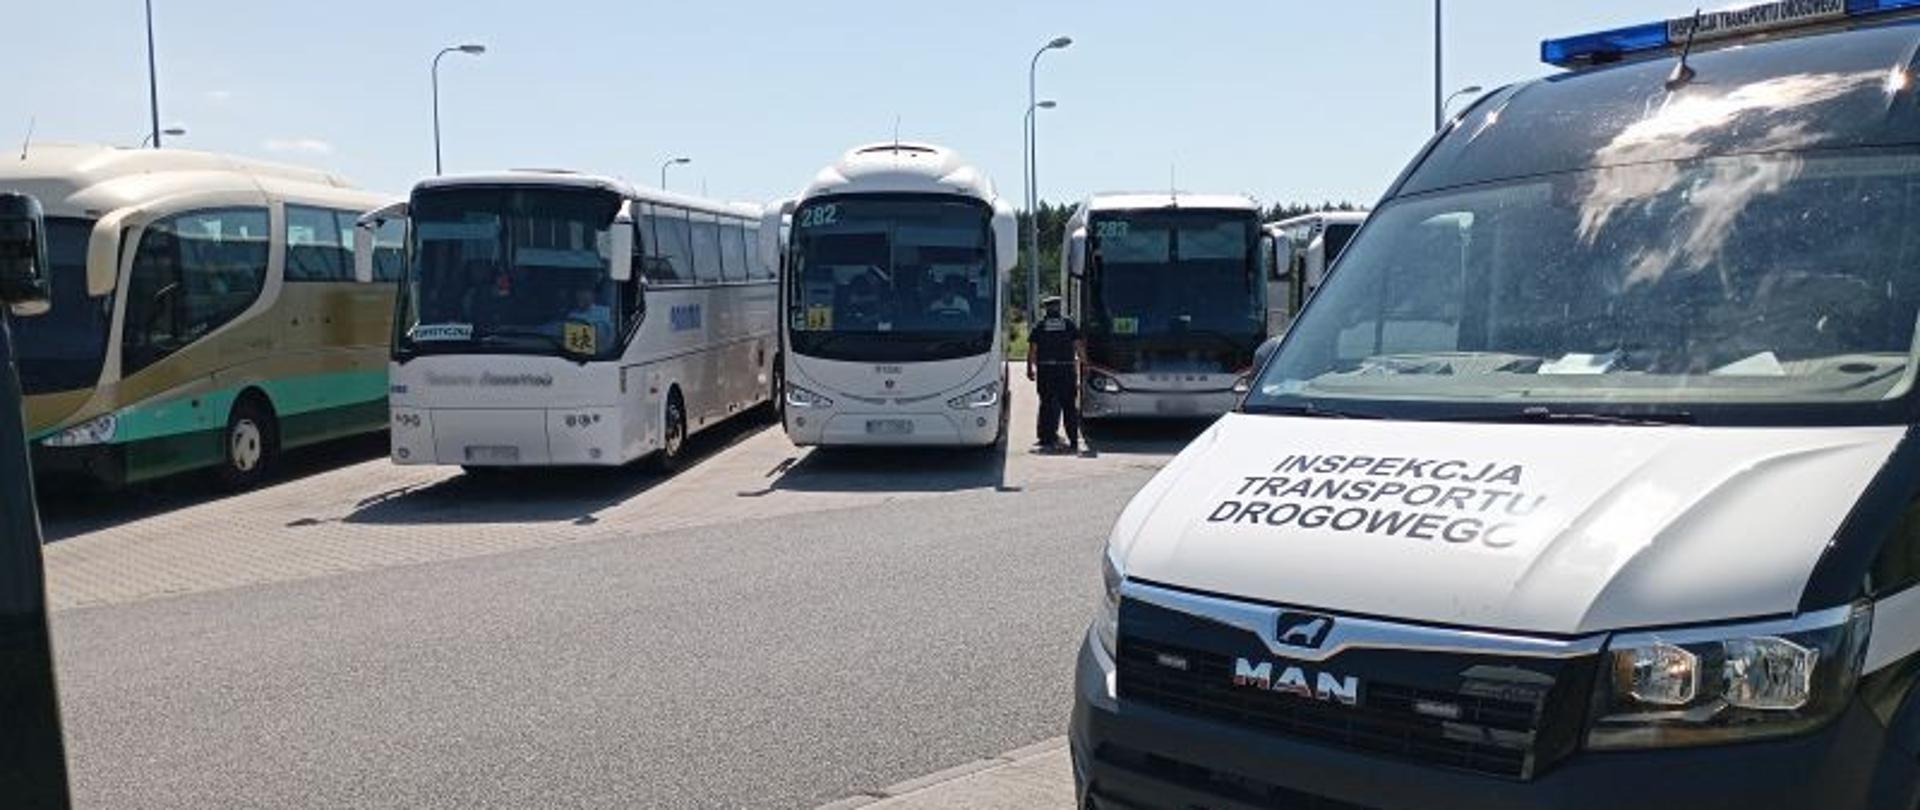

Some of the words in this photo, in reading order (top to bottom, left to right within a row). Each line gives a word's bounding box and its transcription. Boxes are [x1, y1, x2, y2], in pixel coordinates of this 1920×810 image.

[1670, 12, 1717, 37] INSPECJA
[801, 204, 838, 228] 282
[1096, 220, 1130, 238] 283
[1273, 454, 1524, 486] INSPEKCJA
[1235, 476, 1547, 517] TRANSPORTU
[1232, 657, 1359, 705] MAN
